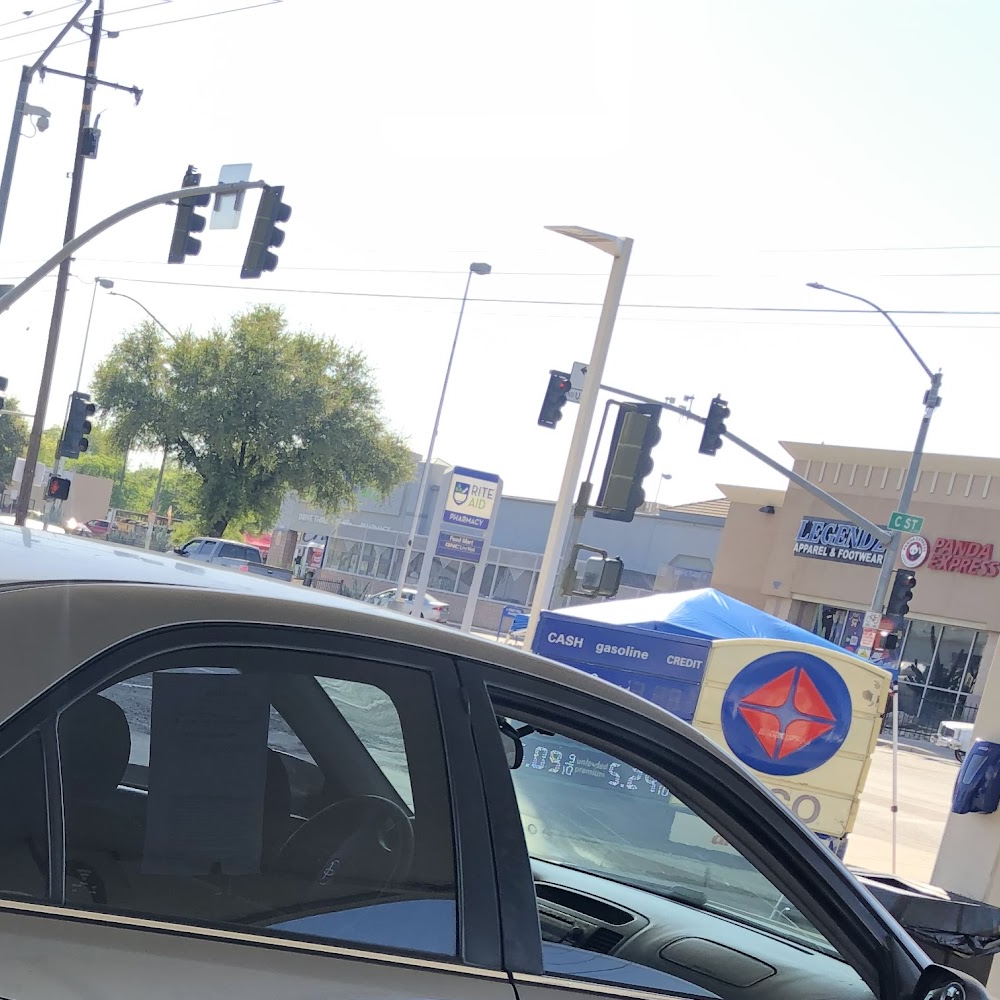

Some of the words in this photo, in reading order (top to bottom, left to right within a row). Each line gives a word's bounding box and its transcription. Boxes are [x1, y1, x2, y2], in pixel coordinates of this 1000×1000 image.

[470, 484, 496, 500] RITE
[467, 497, 487, 510] AID
[448, 512, 485, 527] PHARMACY
[894, 515, 903, 528] C
[903, 517, 919, 530] ST
[793, 542, 828, 556] APPAREL
[829, 547, 836, 558] &
[837, 549, 884, 564] FOOTWEAR
[934, 537, 995, 560] PANDA
[927, 554, 1000, 578] EXPRESS
[547, 632, 584, 648] CASH
[595, 641, 649, 660] gasoline
[666, 654, 704, 670] CREDIT
